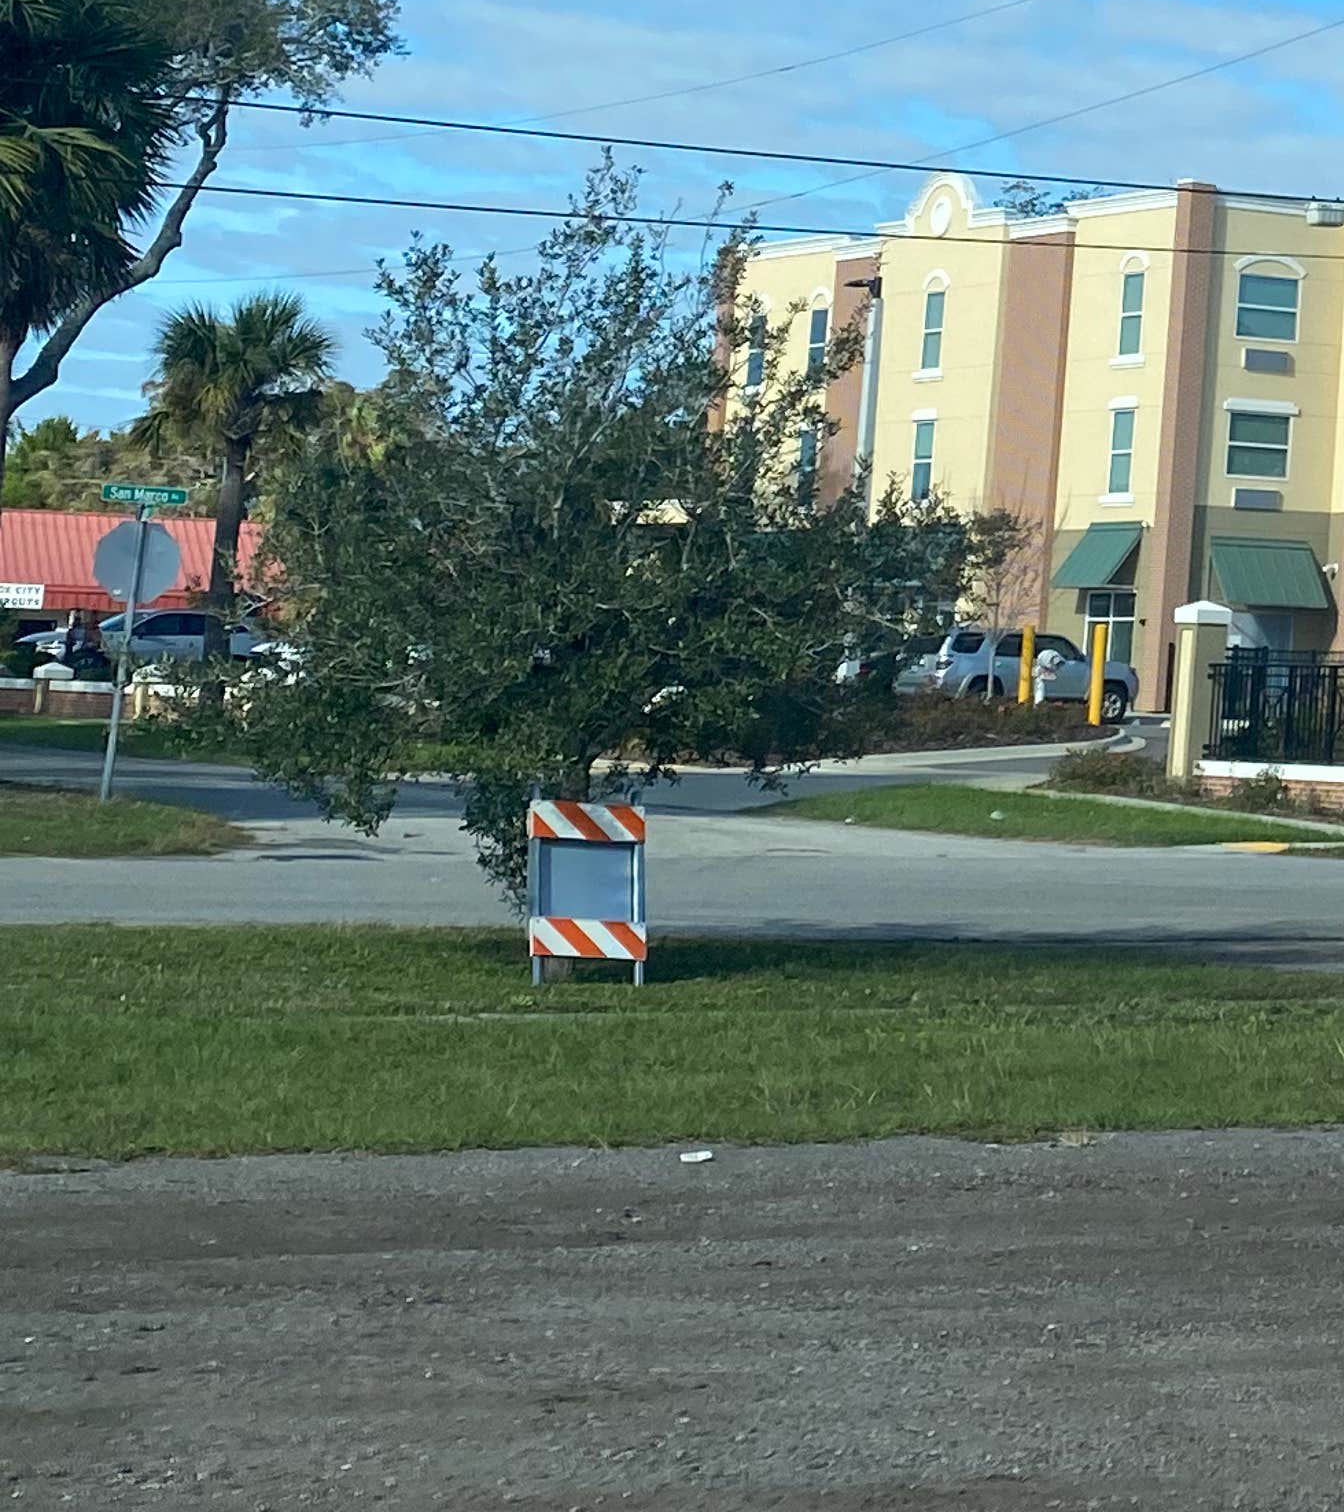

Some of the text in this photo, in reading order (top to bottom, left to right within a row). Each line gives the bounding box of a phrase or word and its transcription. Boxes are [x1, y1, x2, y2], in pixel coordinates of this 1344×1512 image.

[109, 486, 132, 500] San
[133, 488, 169, 503] Marco
[15, 586, 41, 595] CITY
